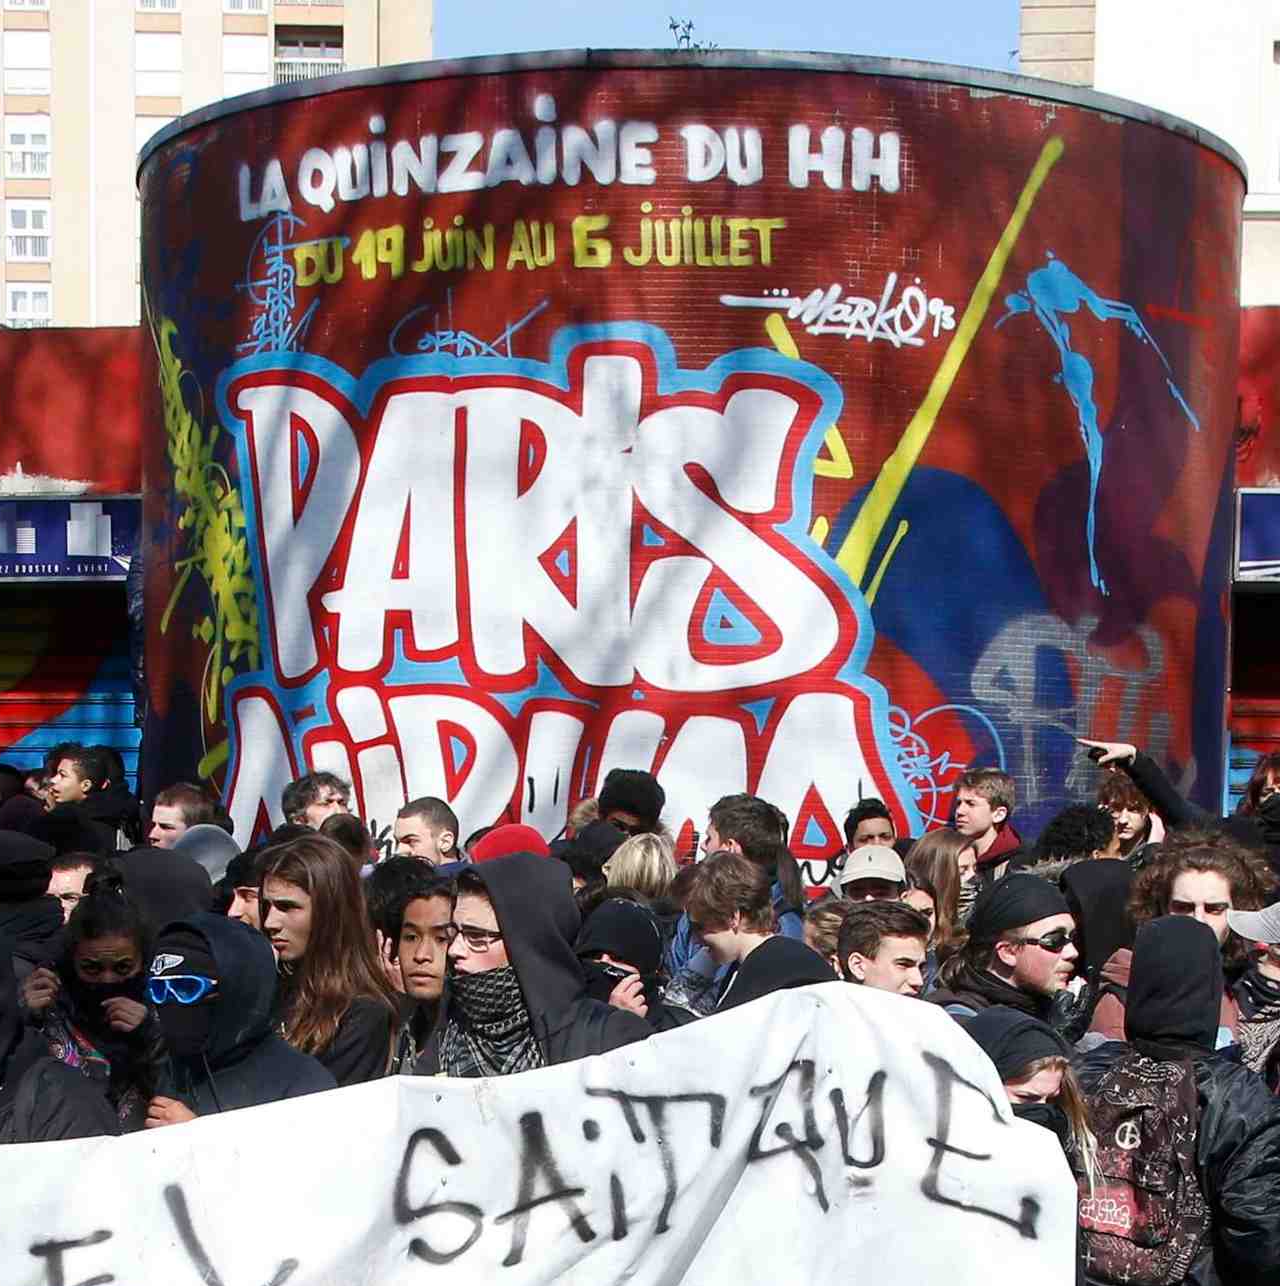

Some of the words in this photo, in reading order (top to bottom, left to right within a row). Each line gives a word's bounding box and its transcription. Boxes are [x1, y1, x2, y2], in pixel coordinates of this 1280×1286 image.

[237, 157, 293, 222] LA
[679, 123, 763, 186] DU
[788, 122, 901, 191] HH
[293, 240, 344, 287] DU
[352, 224, 405, 280] 19
[506, 219, 555, 271] AU
[572, 214, 612, 268] 6
